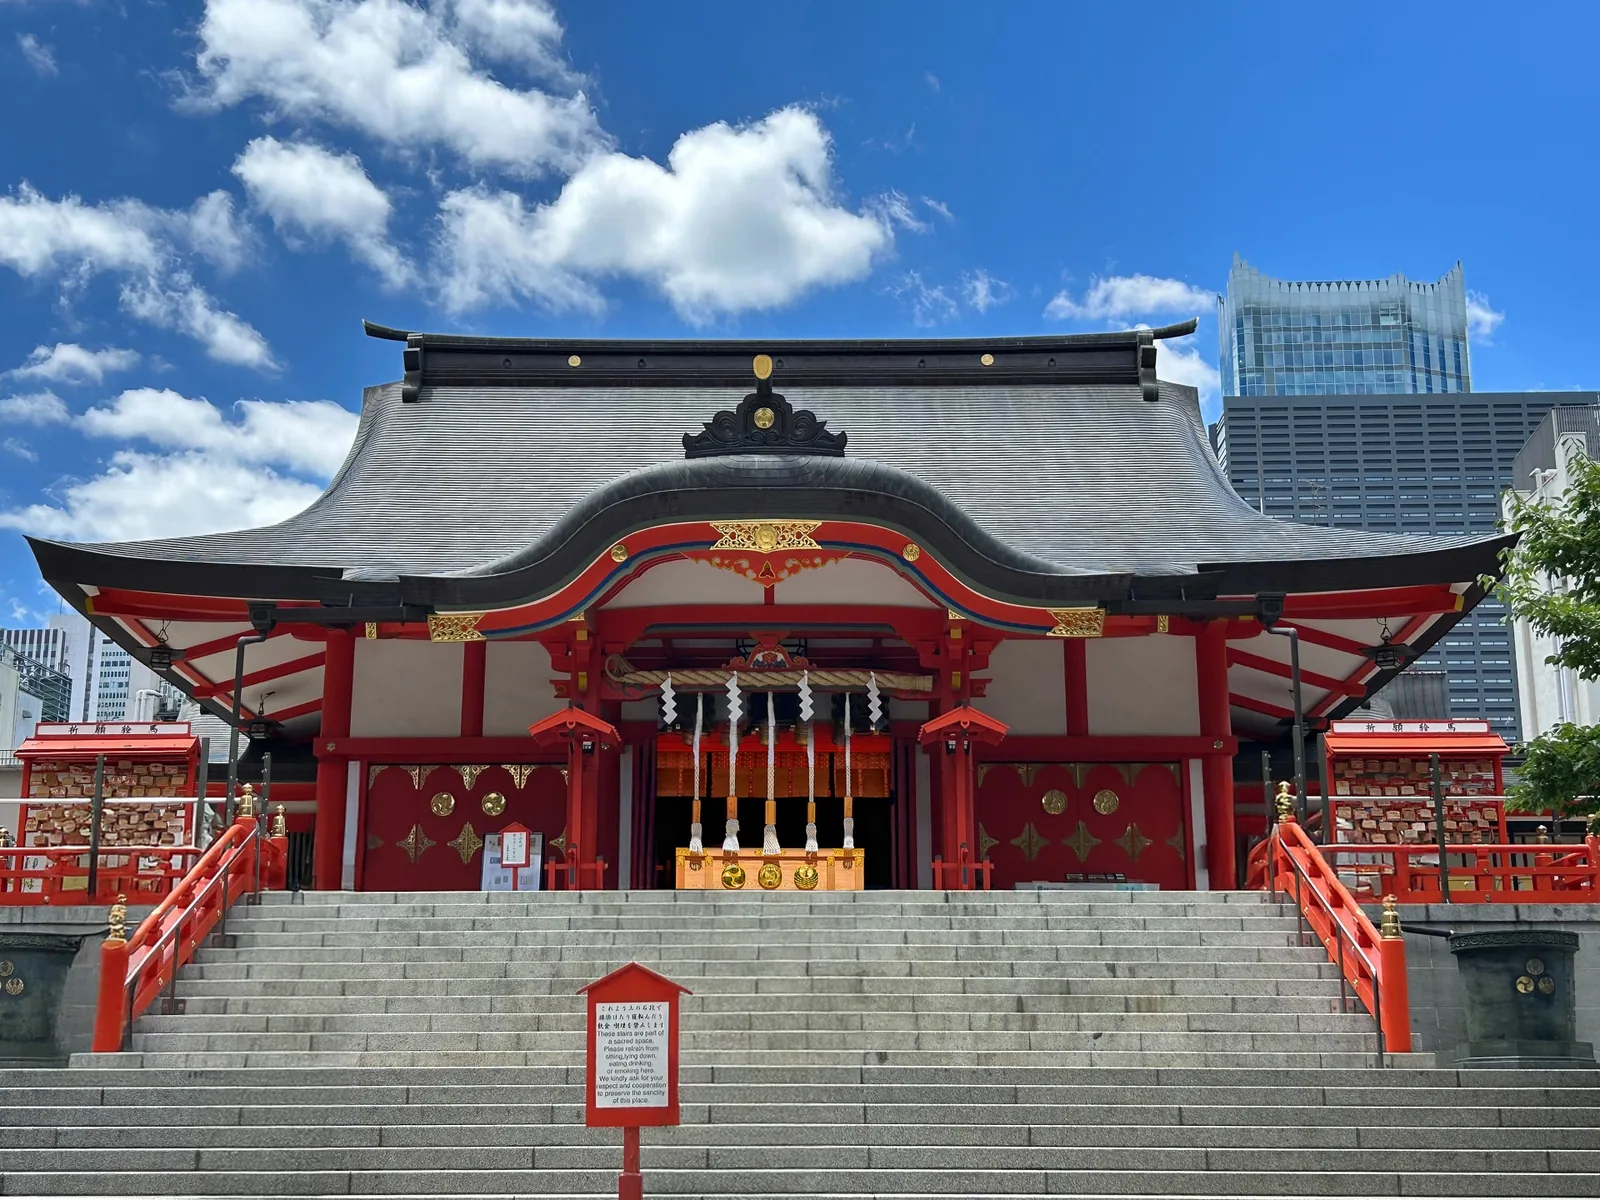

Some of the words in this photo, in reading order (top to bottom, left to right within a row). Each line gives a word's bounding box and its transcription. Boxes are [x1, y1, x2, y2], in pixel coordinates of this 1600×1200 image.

[69, 724, 158, 734] 祈願絵馬
[1366, 723, 1456, 732] 祈願絵馬
